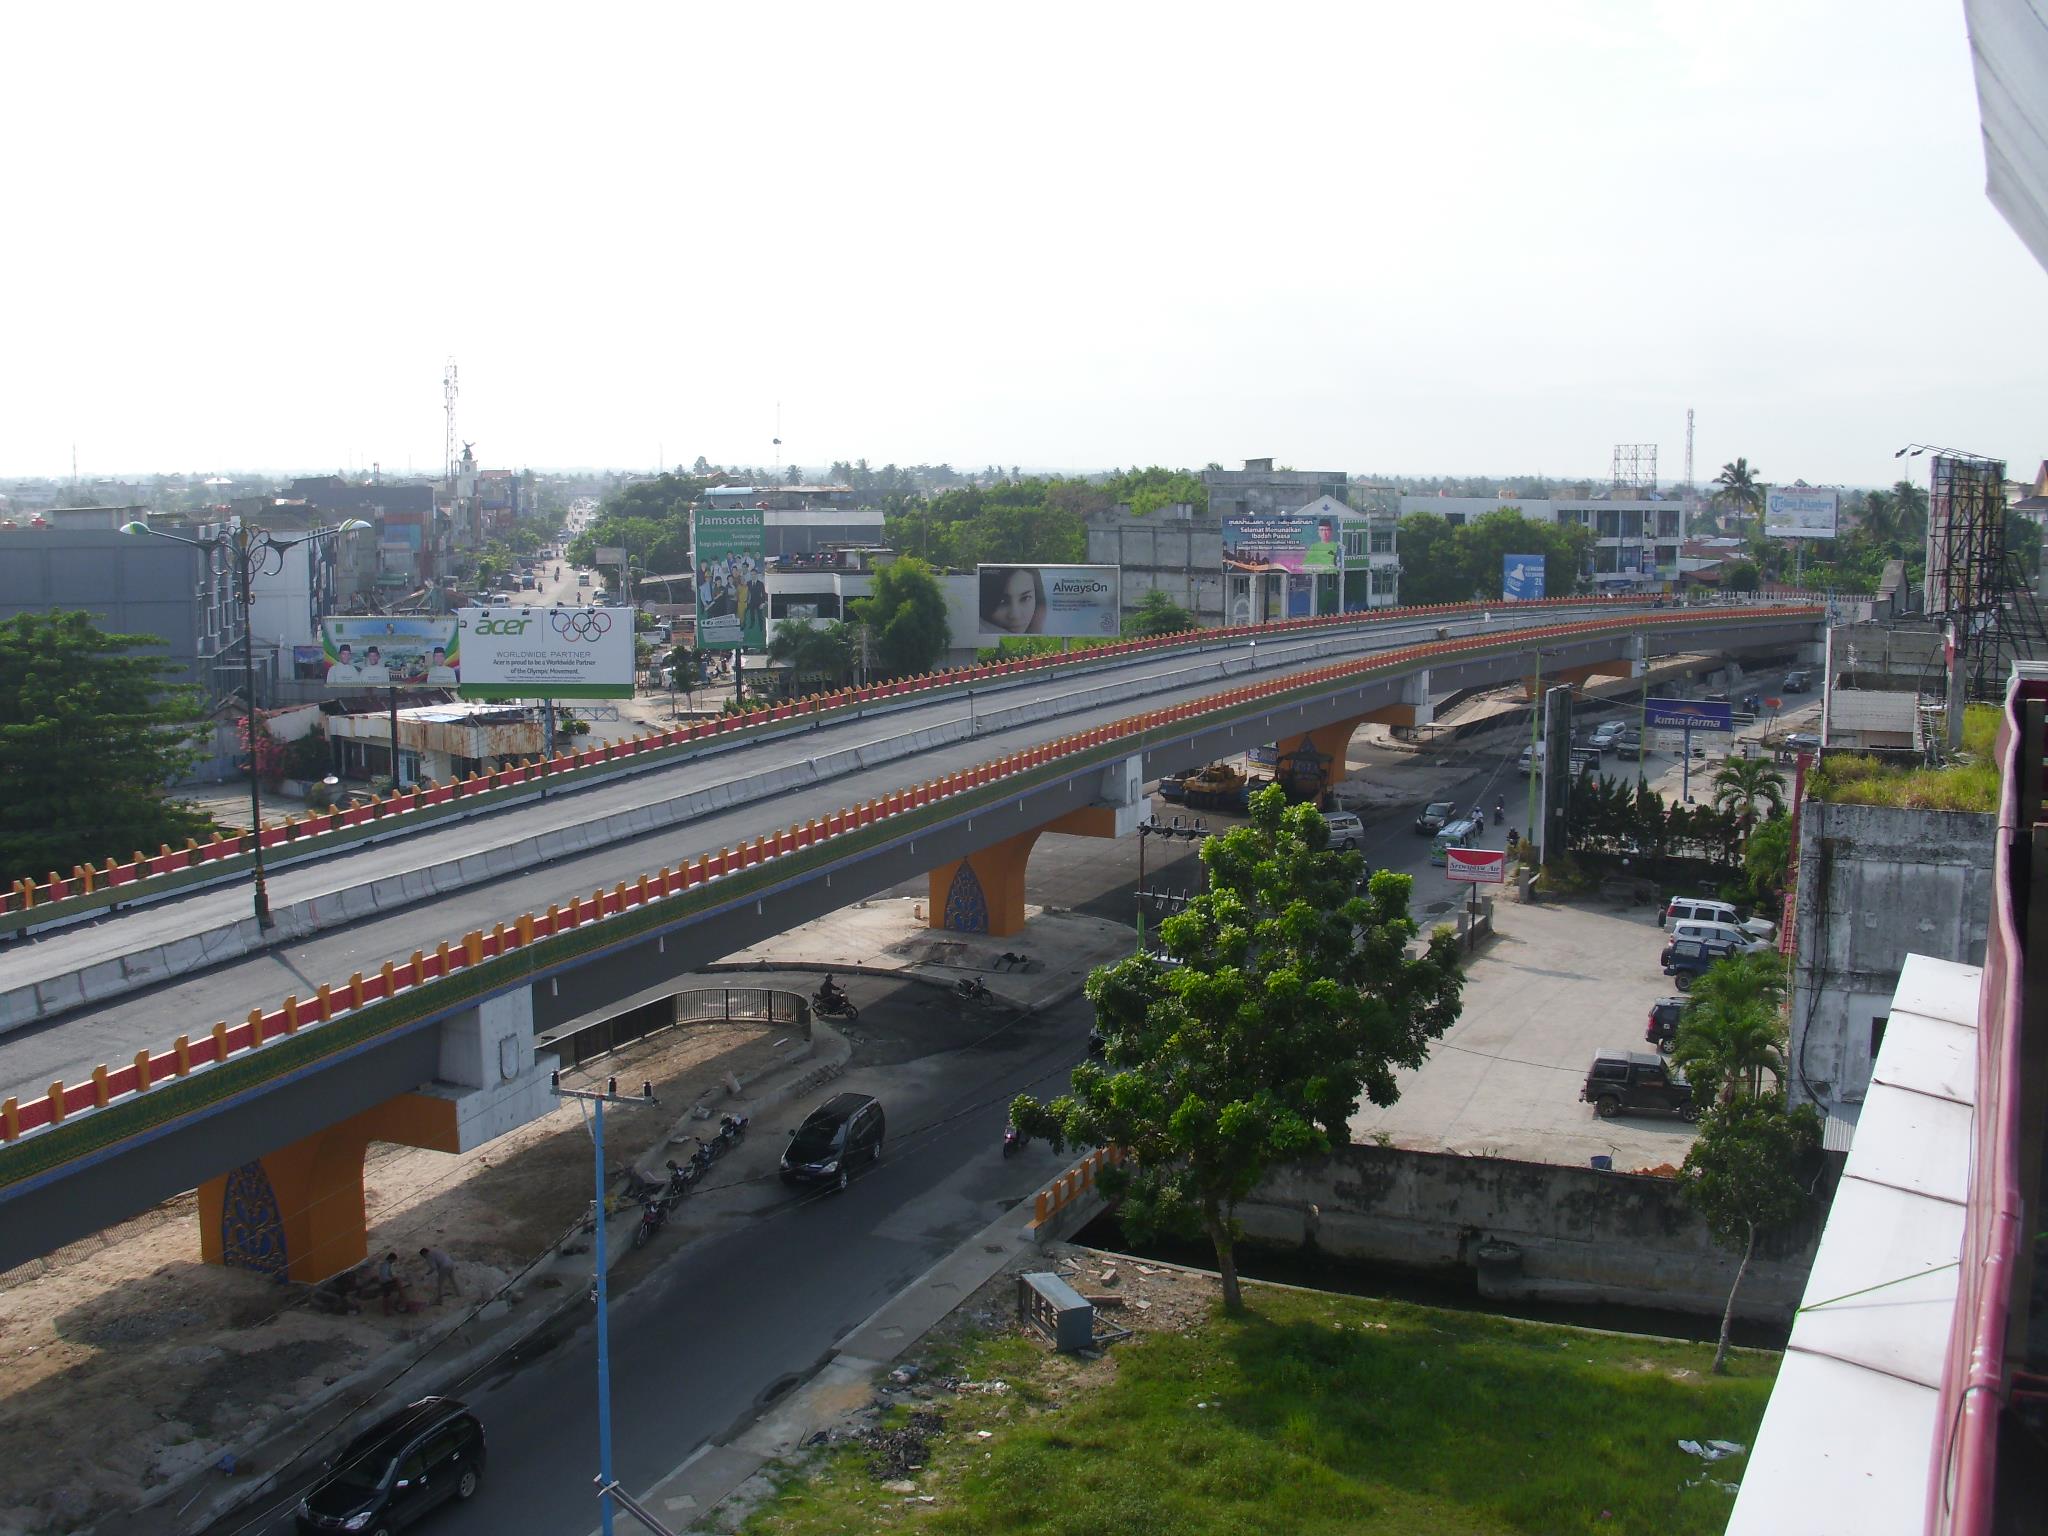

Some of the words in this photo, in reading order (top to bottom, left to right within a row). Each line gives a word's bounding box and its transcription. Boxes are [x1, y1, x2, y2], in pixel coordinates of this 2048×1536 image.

[699, 513, 760, 526] Jamsostek
[1240, 526, 1264, 534] Selamat
[1053, 580, 1108, 593] AlwaysOn
[475, 618, 533, 636] acer
[511, 659, 527, 667] proud
[526, 668, 548, 676] Olympic
[1654, 714, 1685, 726] kimia
[1687, 716, 1721, 728] farma
